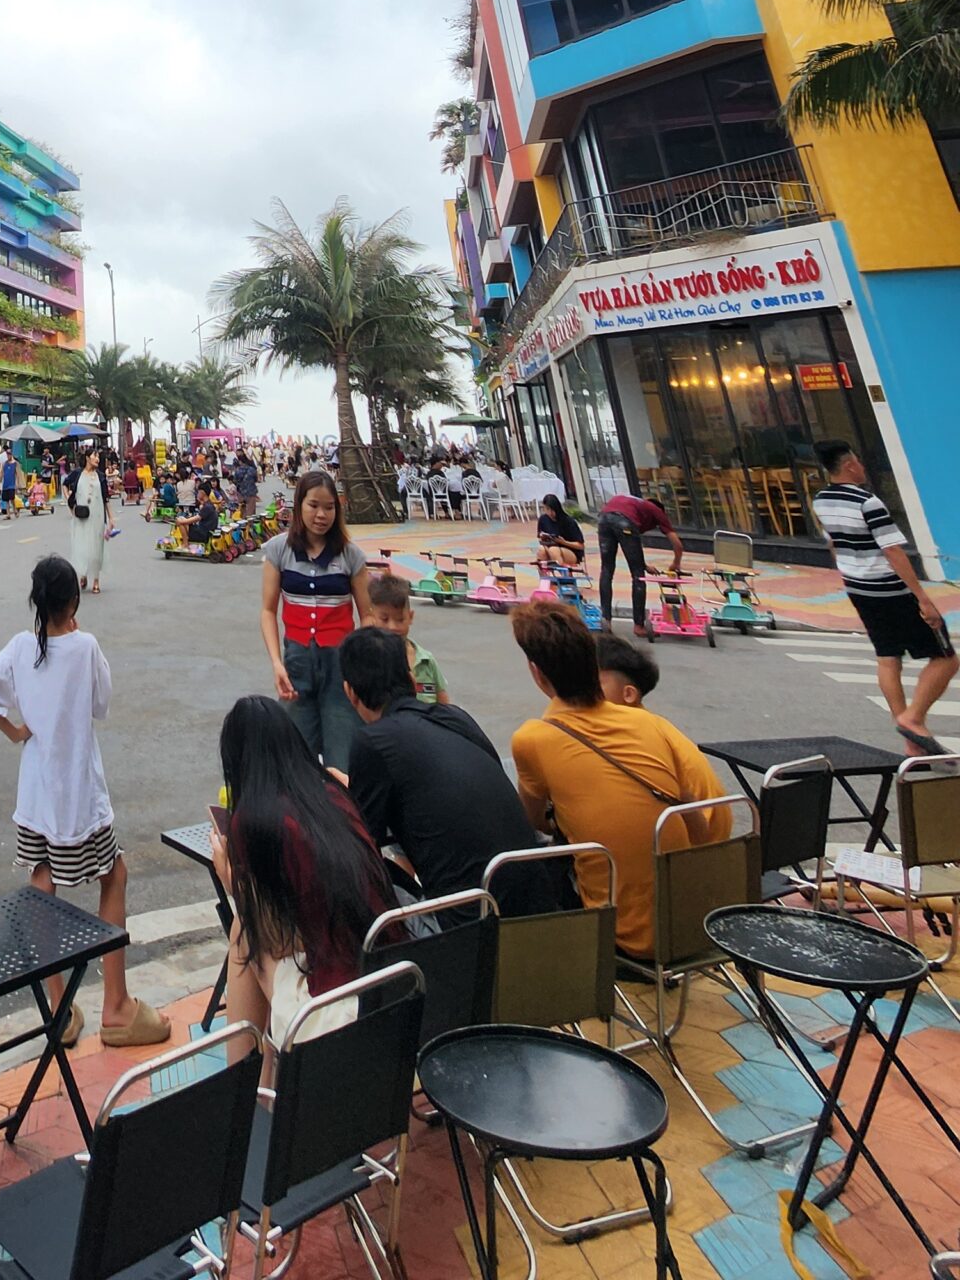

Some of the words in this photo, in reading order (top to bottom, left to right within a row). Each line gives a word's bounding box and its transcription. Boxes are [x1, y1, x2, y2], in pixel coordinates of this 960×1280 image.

[611, 276, 642, 309] HẢI
[641, 272, 675, 305] SẢN
[775, 248, 821, 286] KHÔ
